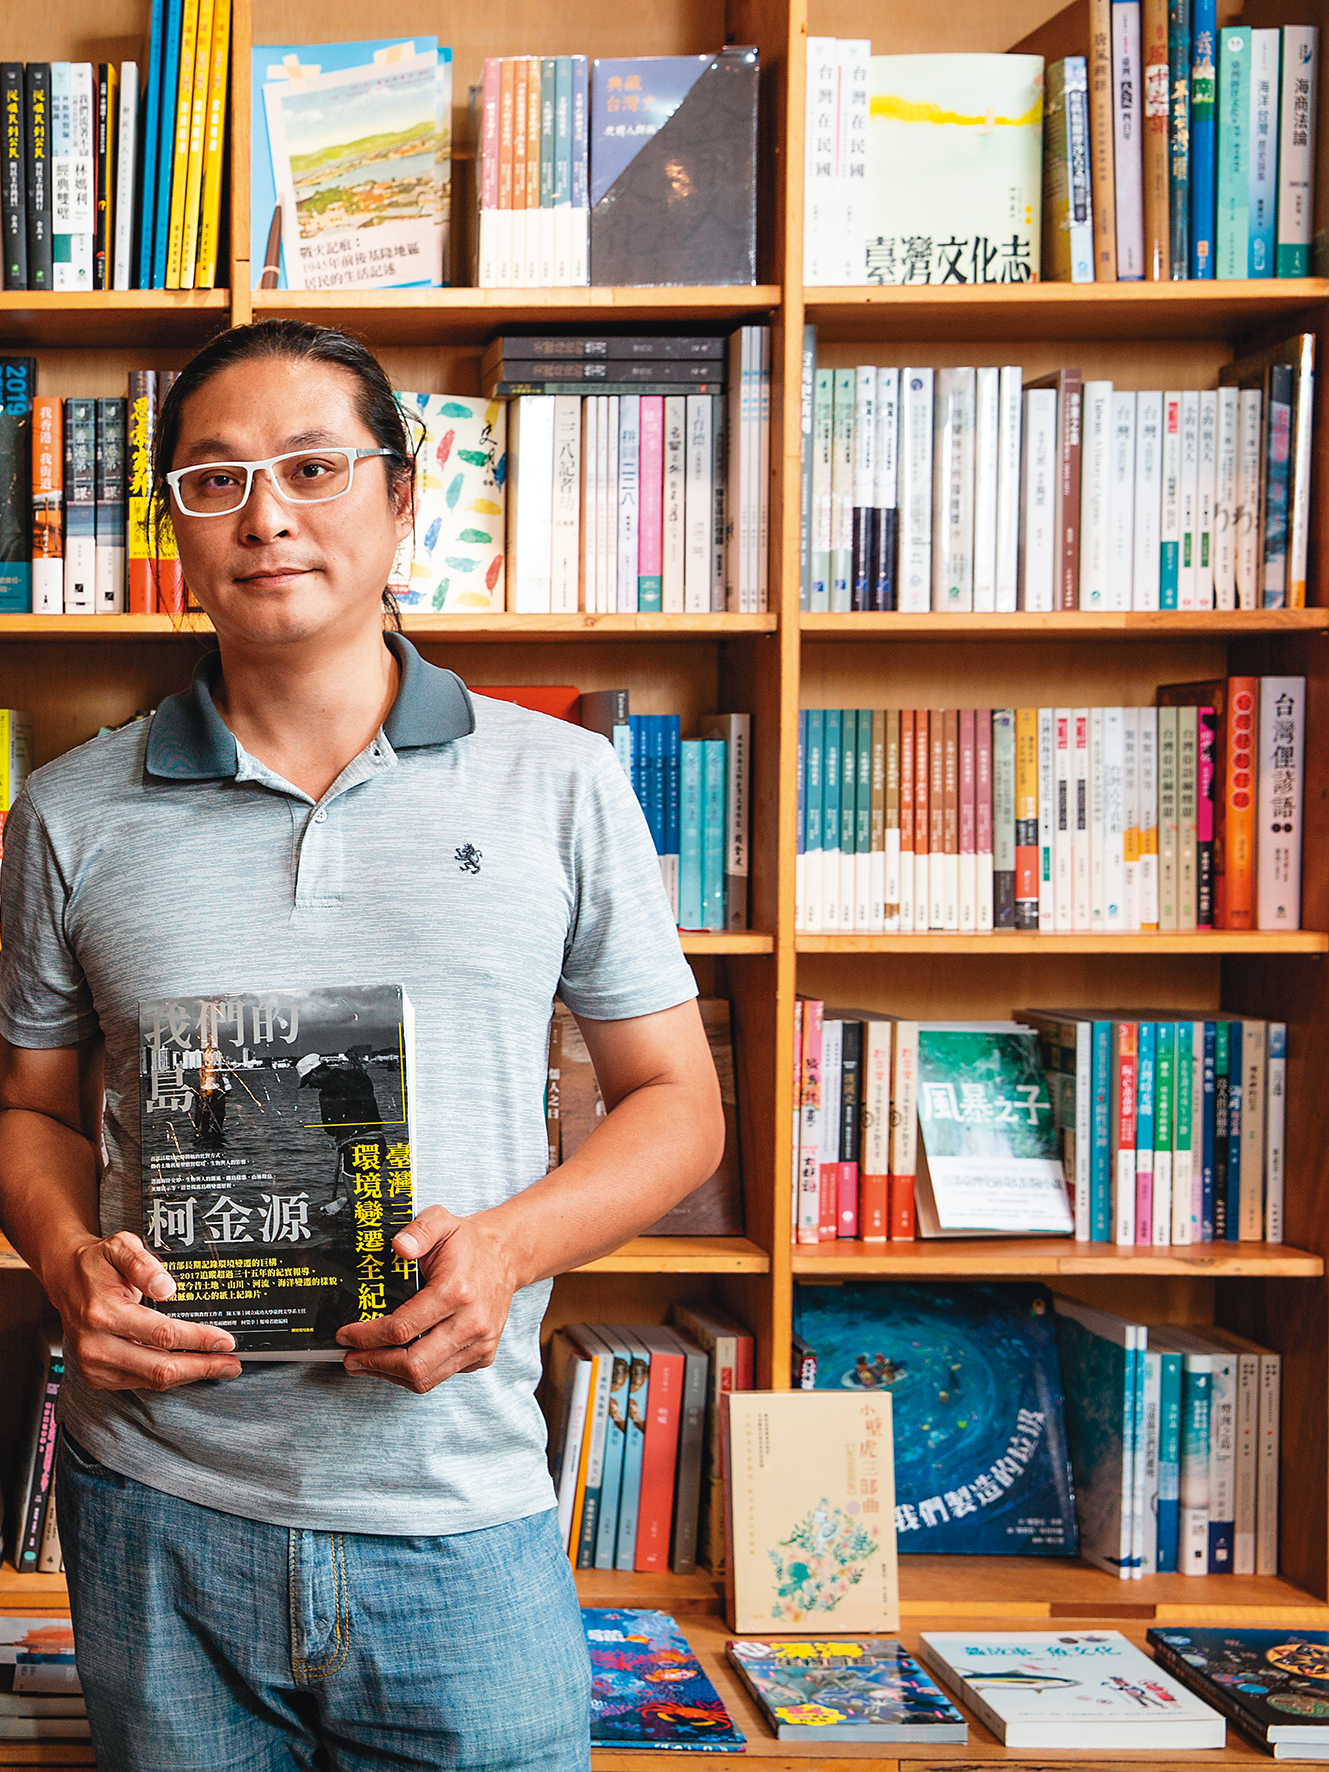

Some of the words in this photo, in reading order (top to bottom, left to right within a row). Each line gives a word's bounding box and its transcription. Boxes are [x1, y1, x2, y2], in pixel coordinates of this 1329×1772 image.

[865, 235, 1032, 285] 臺灣文化志
[5, 365, 28, 416] 2019
[143, 1000, 301, 1050] 我們的
[146, 1053, 195, 1113] 島
[922, 1081, 1053, 1126] 風暴之子
[146, 1192, 312, 1249] 柯金源
[385, 1142, 417, 1281] 臺灣三年
[894, 1408, 1046, 1533] 我們製造的垃圾
